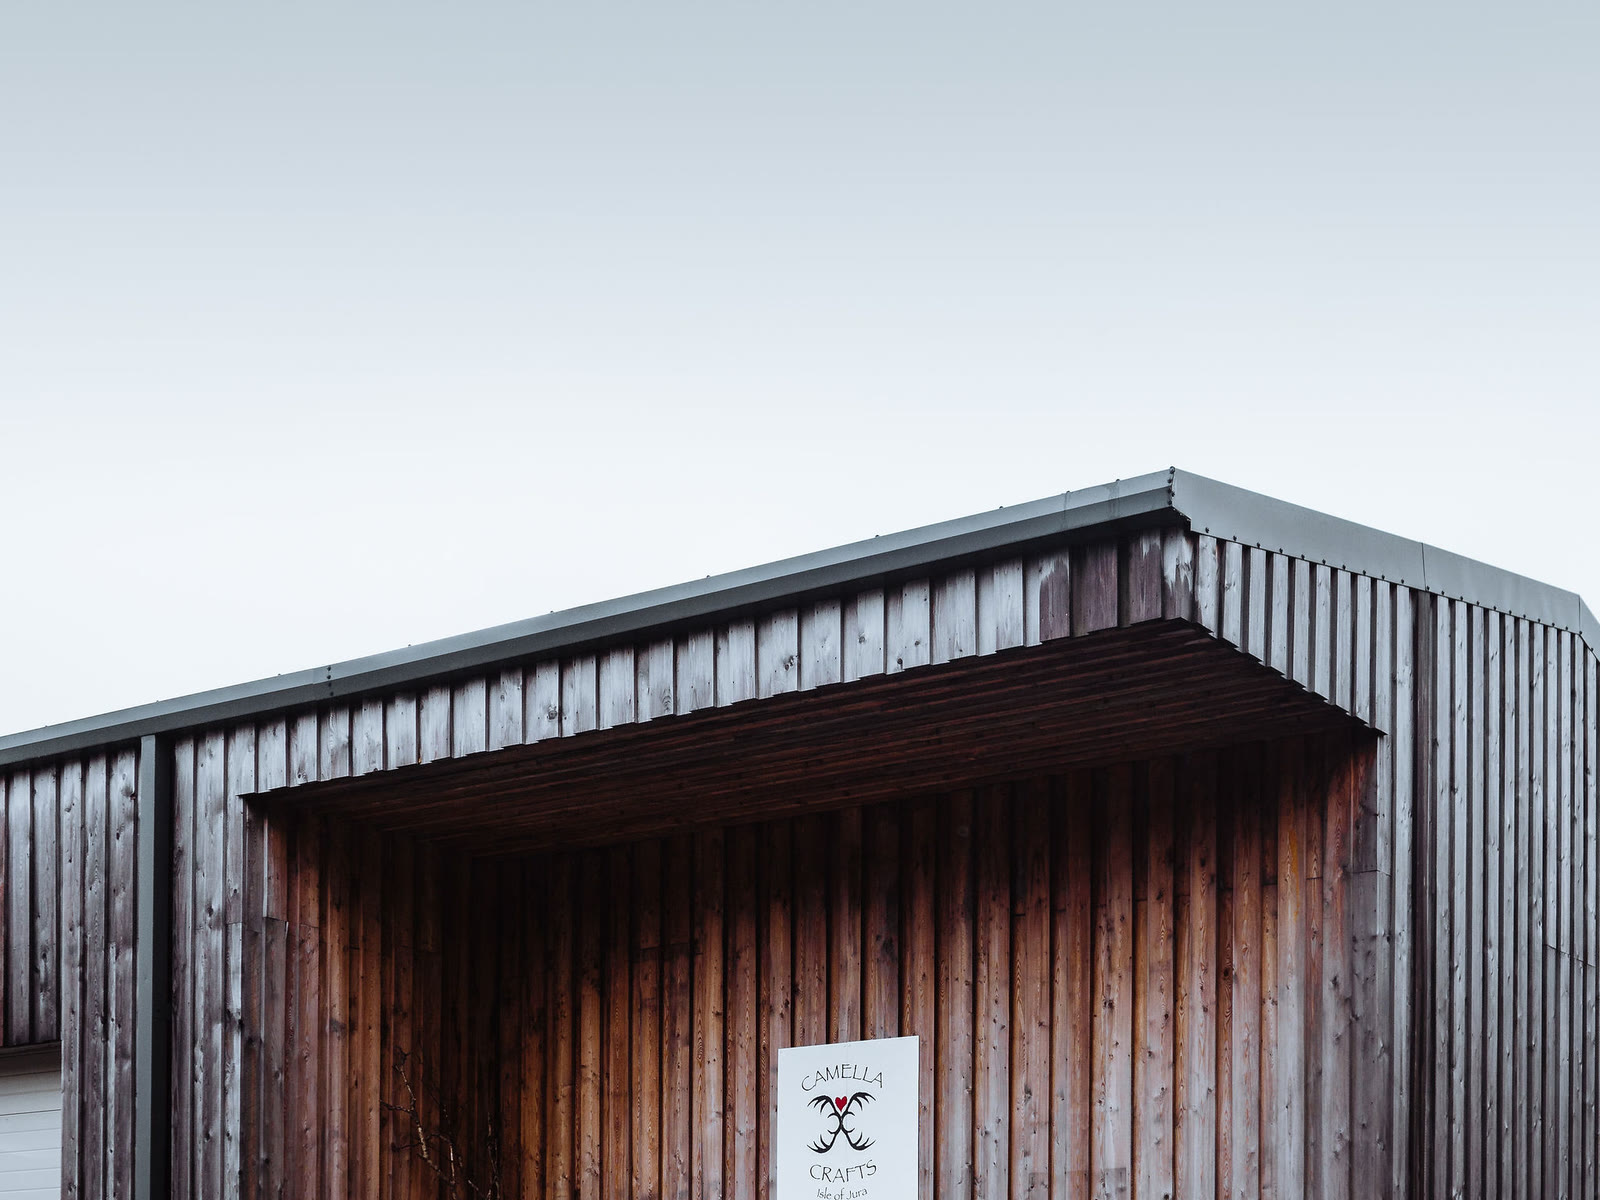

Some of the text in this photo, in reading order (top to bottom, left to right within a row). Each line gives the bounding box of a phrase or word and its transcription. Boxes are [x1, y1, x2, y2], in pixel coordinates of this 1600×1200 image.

[801, 1064, 883, 1091] CAMELLA
[809, 1159, 877, 1183] CRAFTS
[817, 1187, 868, 1200] Isle of Jura
